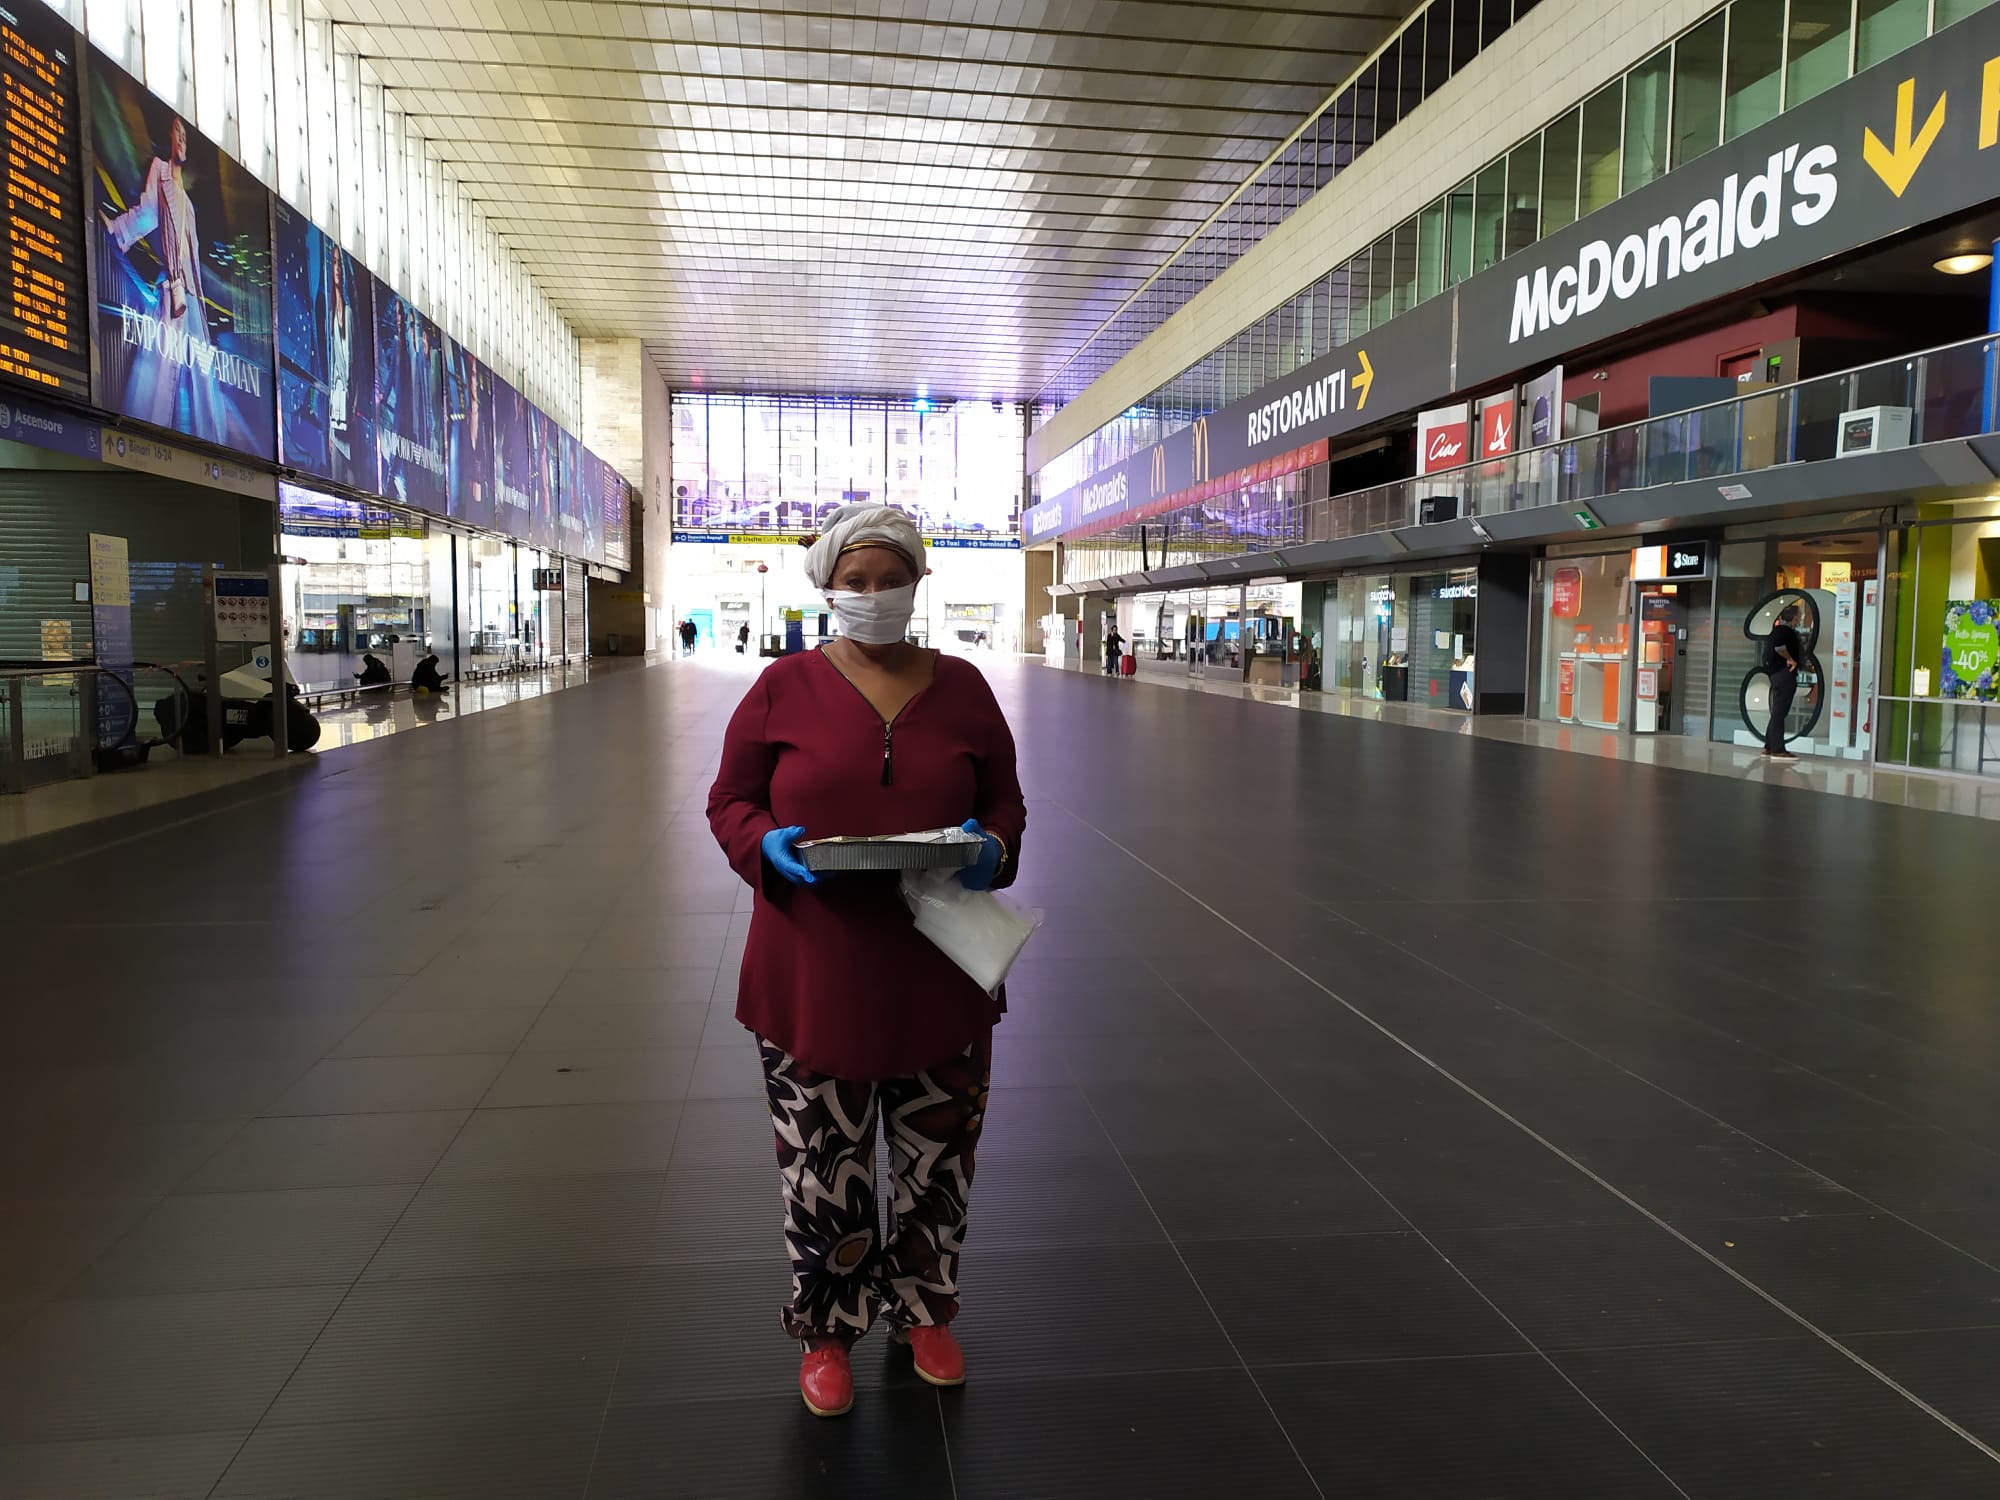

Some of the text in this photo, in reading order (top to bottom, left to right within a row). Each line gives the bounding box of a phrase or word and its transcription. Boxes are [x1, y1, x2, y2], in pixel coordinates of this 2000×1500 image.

[1509, 143, 1838, 344] McDonald's
[122, 303, 196, 369] EMPORIO
[213, 350, 262, 398] ARMANI
[1247, 368, 1346, 448] RISTORANTI
[14, 408, 64, 435] Ascensore
[1428, 432, 1462, 461] Ciao
[1082, 471, 1127, 517] McDonald's
[1031, 502, 1062, 537] McDonald's
[946, 539, 960, 547] Taxi
[979, 539, 1018, 548] Terminal Bus
[1681, 553, 1699, 566] Store
[1370, 589, 1392, 600] swatch
[1440, 585, 1465, 598] swatch
[259, 656, 267, 668] 3
[1952, 649, 1989, 671] -40%
